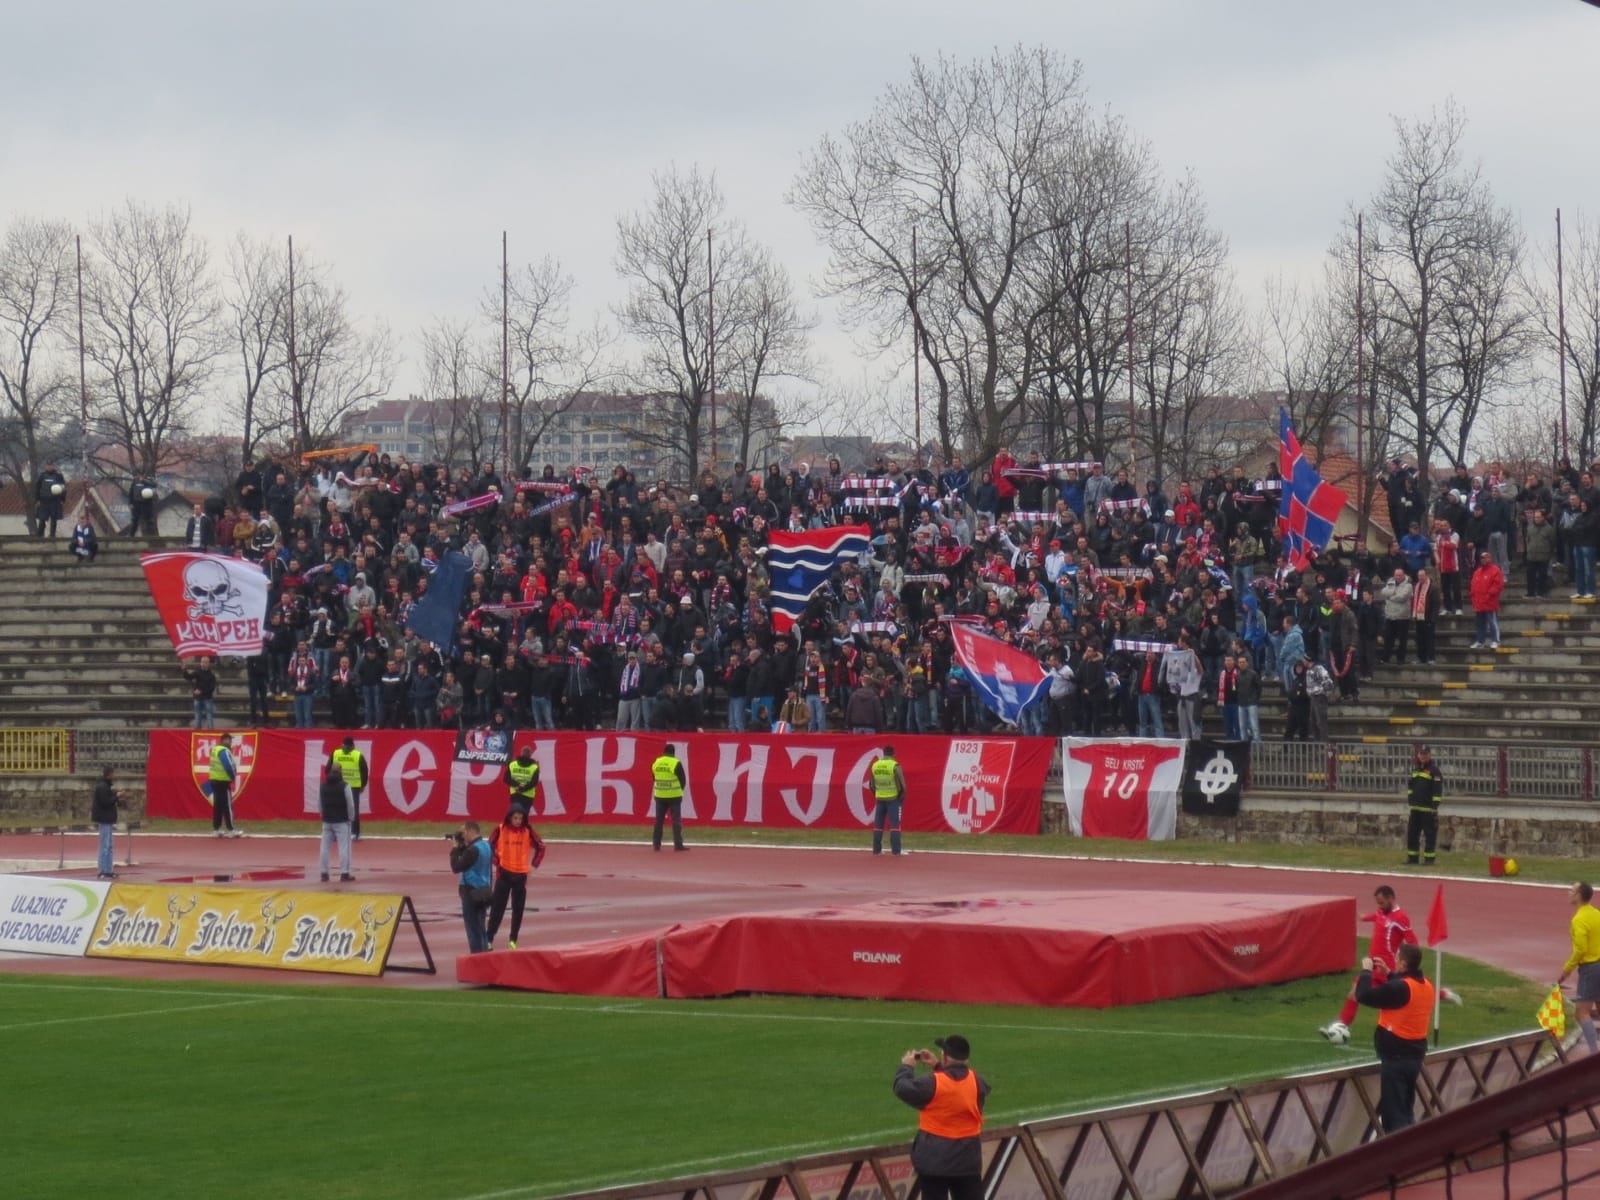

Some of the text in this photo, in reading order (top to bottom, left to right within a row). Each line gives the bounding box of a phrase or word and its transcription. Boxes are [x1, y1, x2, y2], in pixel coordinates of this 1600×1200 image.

[955, 742, 978, 754] 1923
[951, 773, 1001, 784] РАДНИЧКИ
[1103, 771, 1139, 799] 10
[11, 894, 68, 917] ULAZNICE
[0, 919, 83, 946] SVE DOGAĐAJE
[95, 906, 161, 948] Jelen
[187, 910, 255, 953] Jelen
[285, 916, 355, 959] Jelen
[852, 951, 902, 964] POLANIK
